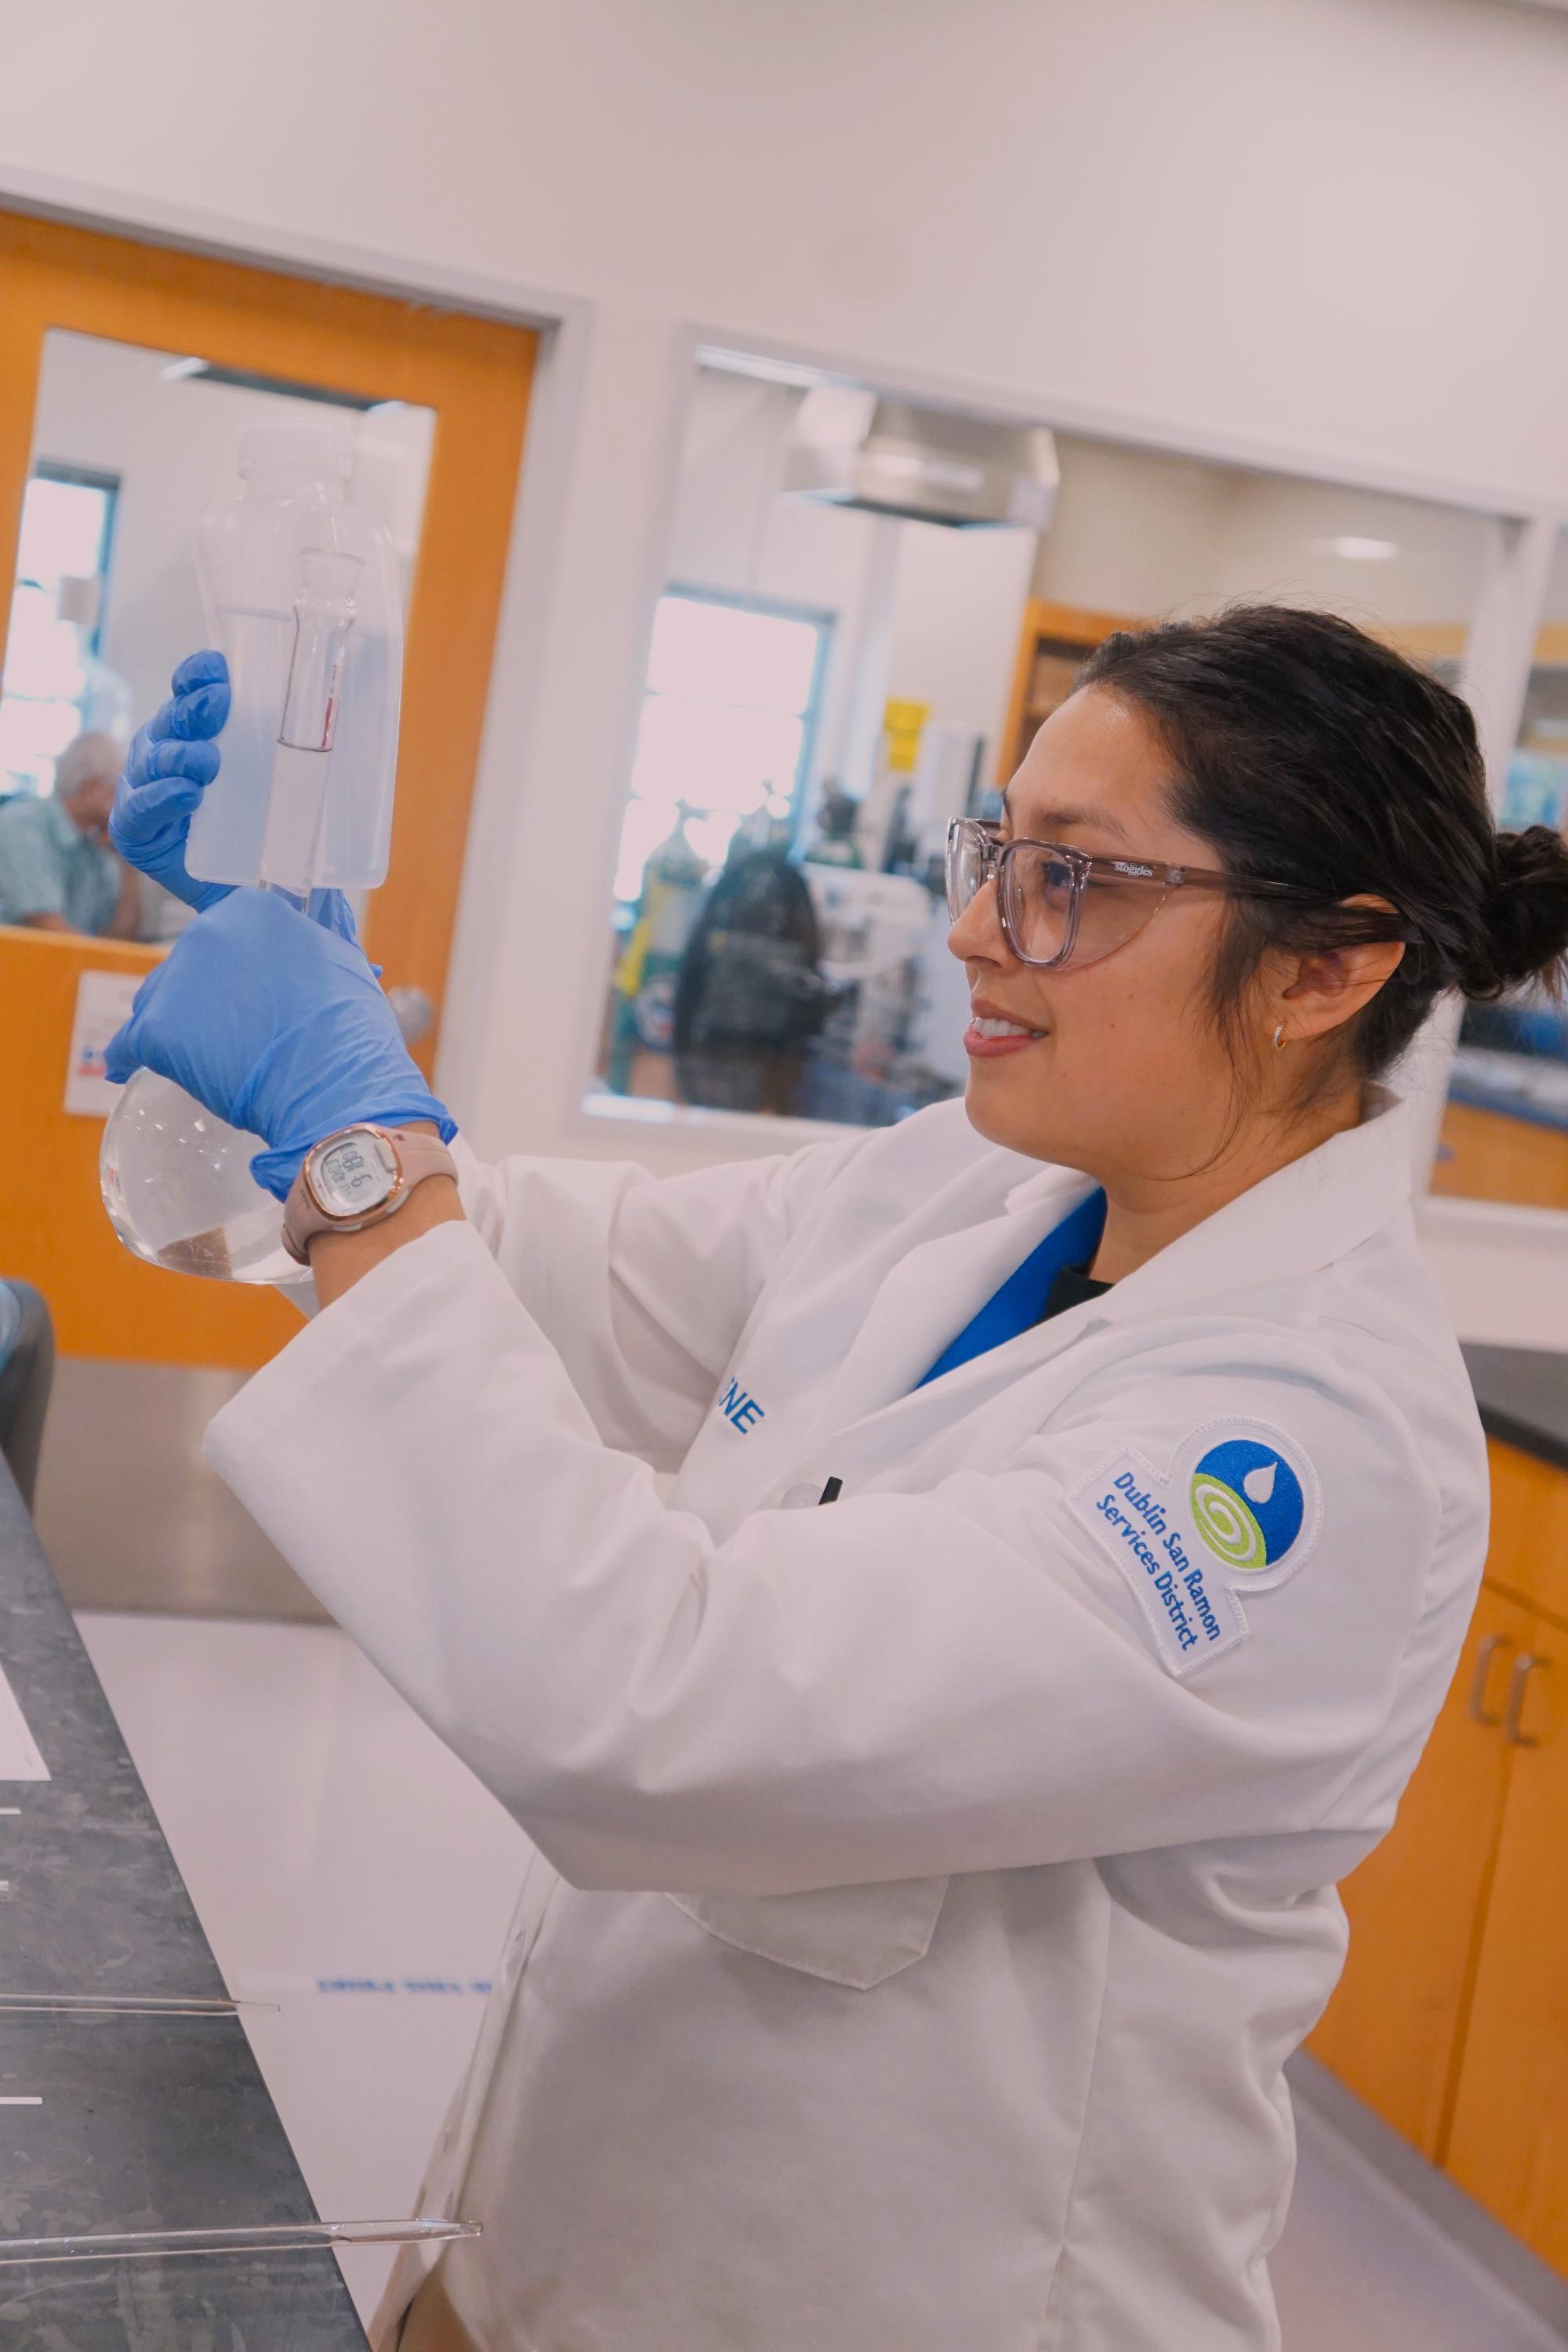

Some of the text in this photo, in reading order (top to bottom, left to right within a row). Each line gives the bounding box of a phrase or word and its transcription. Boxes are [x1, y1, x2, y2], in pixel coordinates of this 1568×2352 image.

[1116, 863, 1152, 877] stoggles
[717, 1376, 765, 1435] NE
[1097, 1494, 1197, 1650] Services District
[1114, 1472, 1221, 1641] Dublin San Ramon
